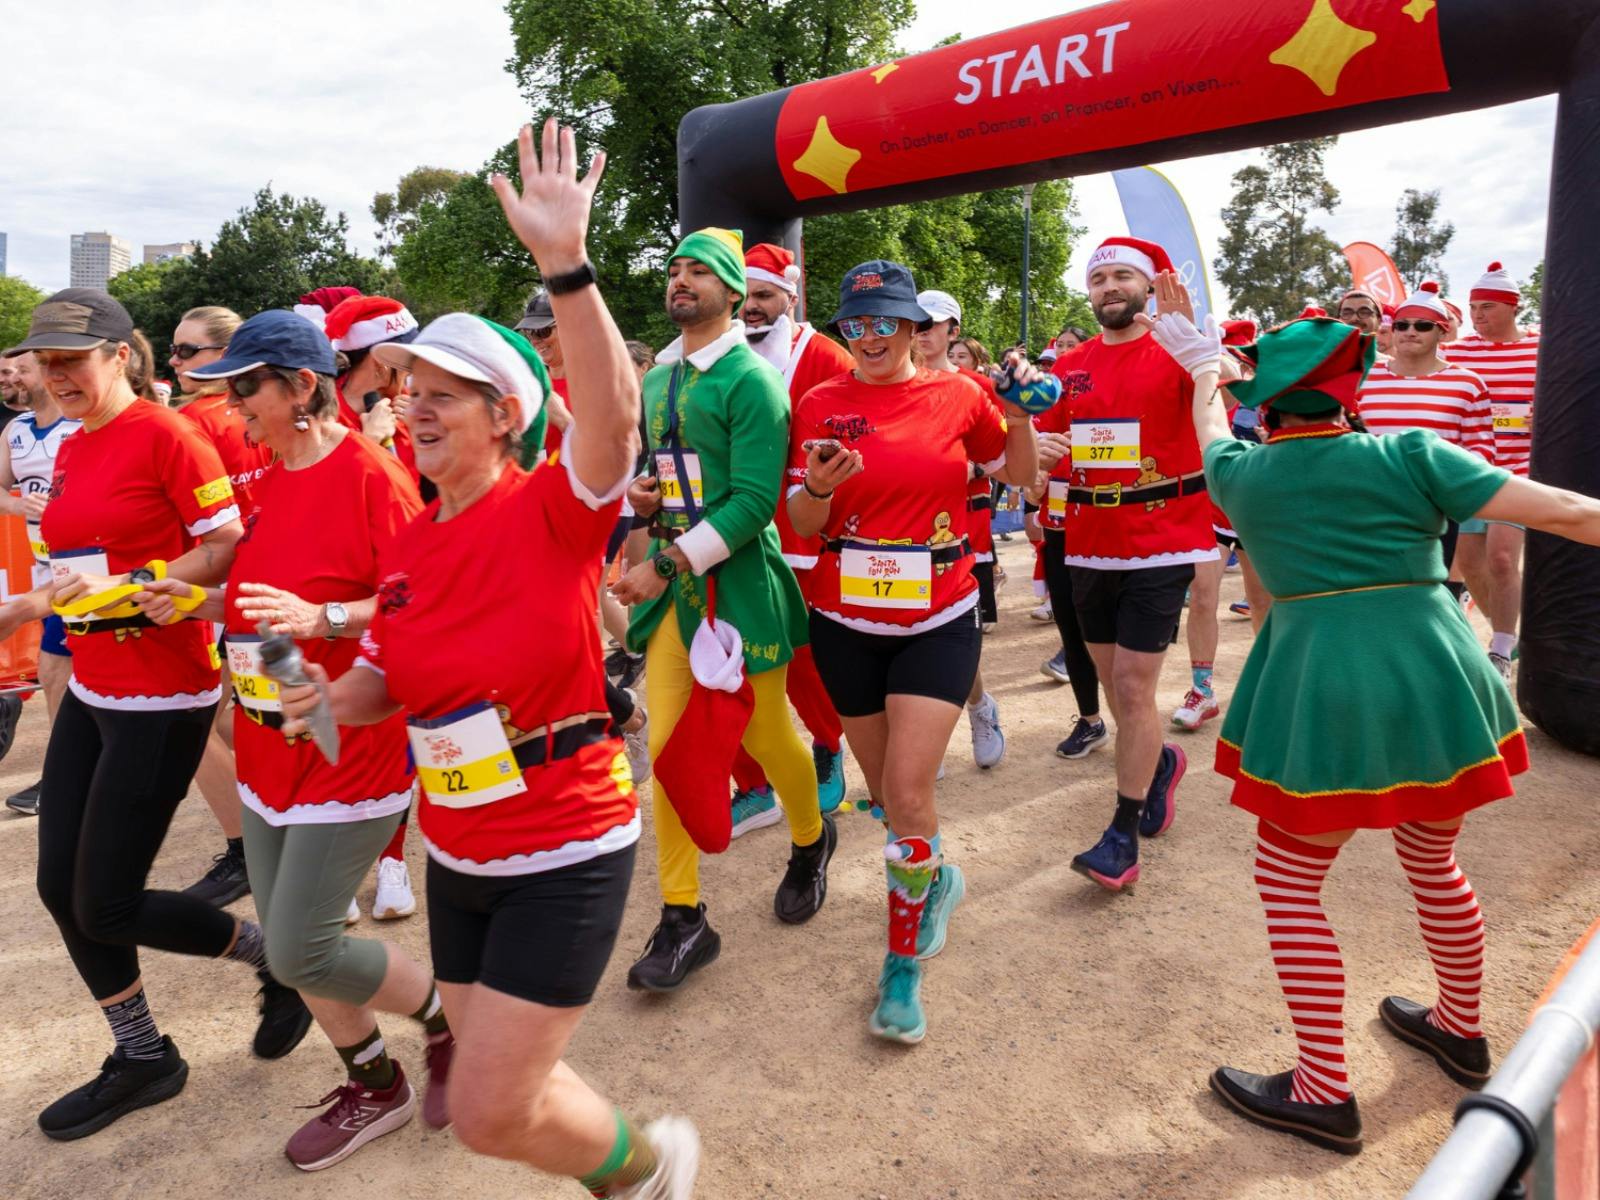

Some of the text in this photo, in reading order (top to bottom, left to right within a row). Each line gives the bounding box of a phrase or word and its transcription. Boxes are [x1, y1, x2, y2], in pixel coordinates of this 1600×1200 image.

[954, 21, 1131, 105] START
[879, 140, 899, 155] On
[903, 131, 954, 151] Dasher,
[957, 126, 975, 140] on
[978, 115, 1037, 135] Dancer,
[1041, 110, 1060, 123] on
[1064, 95, 1137, 118] Prancer,
[1140, 88, 1164, 104] on
[1089, 447, 1114, 460] 377
[872, 580, 893, 597] 17
[441, 770, 470, 792] 22
